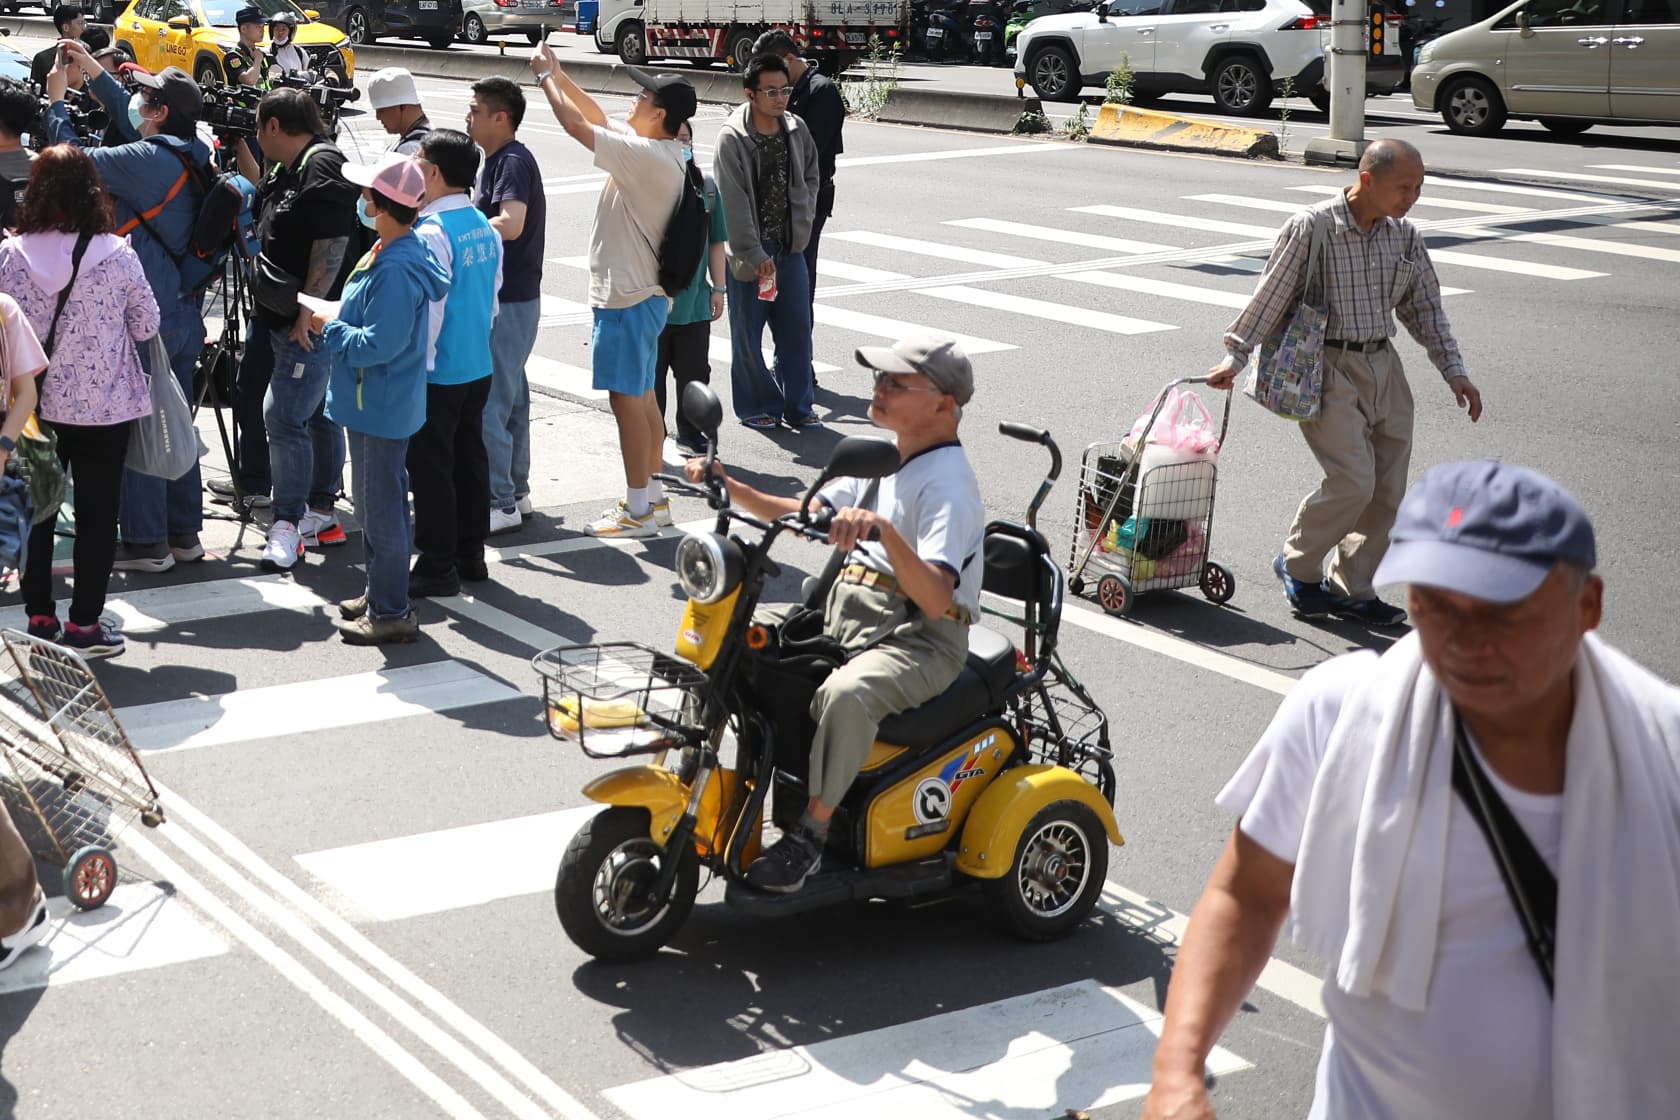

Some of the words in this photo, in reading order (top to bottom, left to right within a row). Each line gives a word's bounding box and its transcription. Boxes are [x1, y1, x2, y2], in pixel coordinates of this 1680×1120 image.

[166, 44, 178, 54] LINE
[178, 46, 187, 56] GO
[954, 768, 985, 780] GTA
